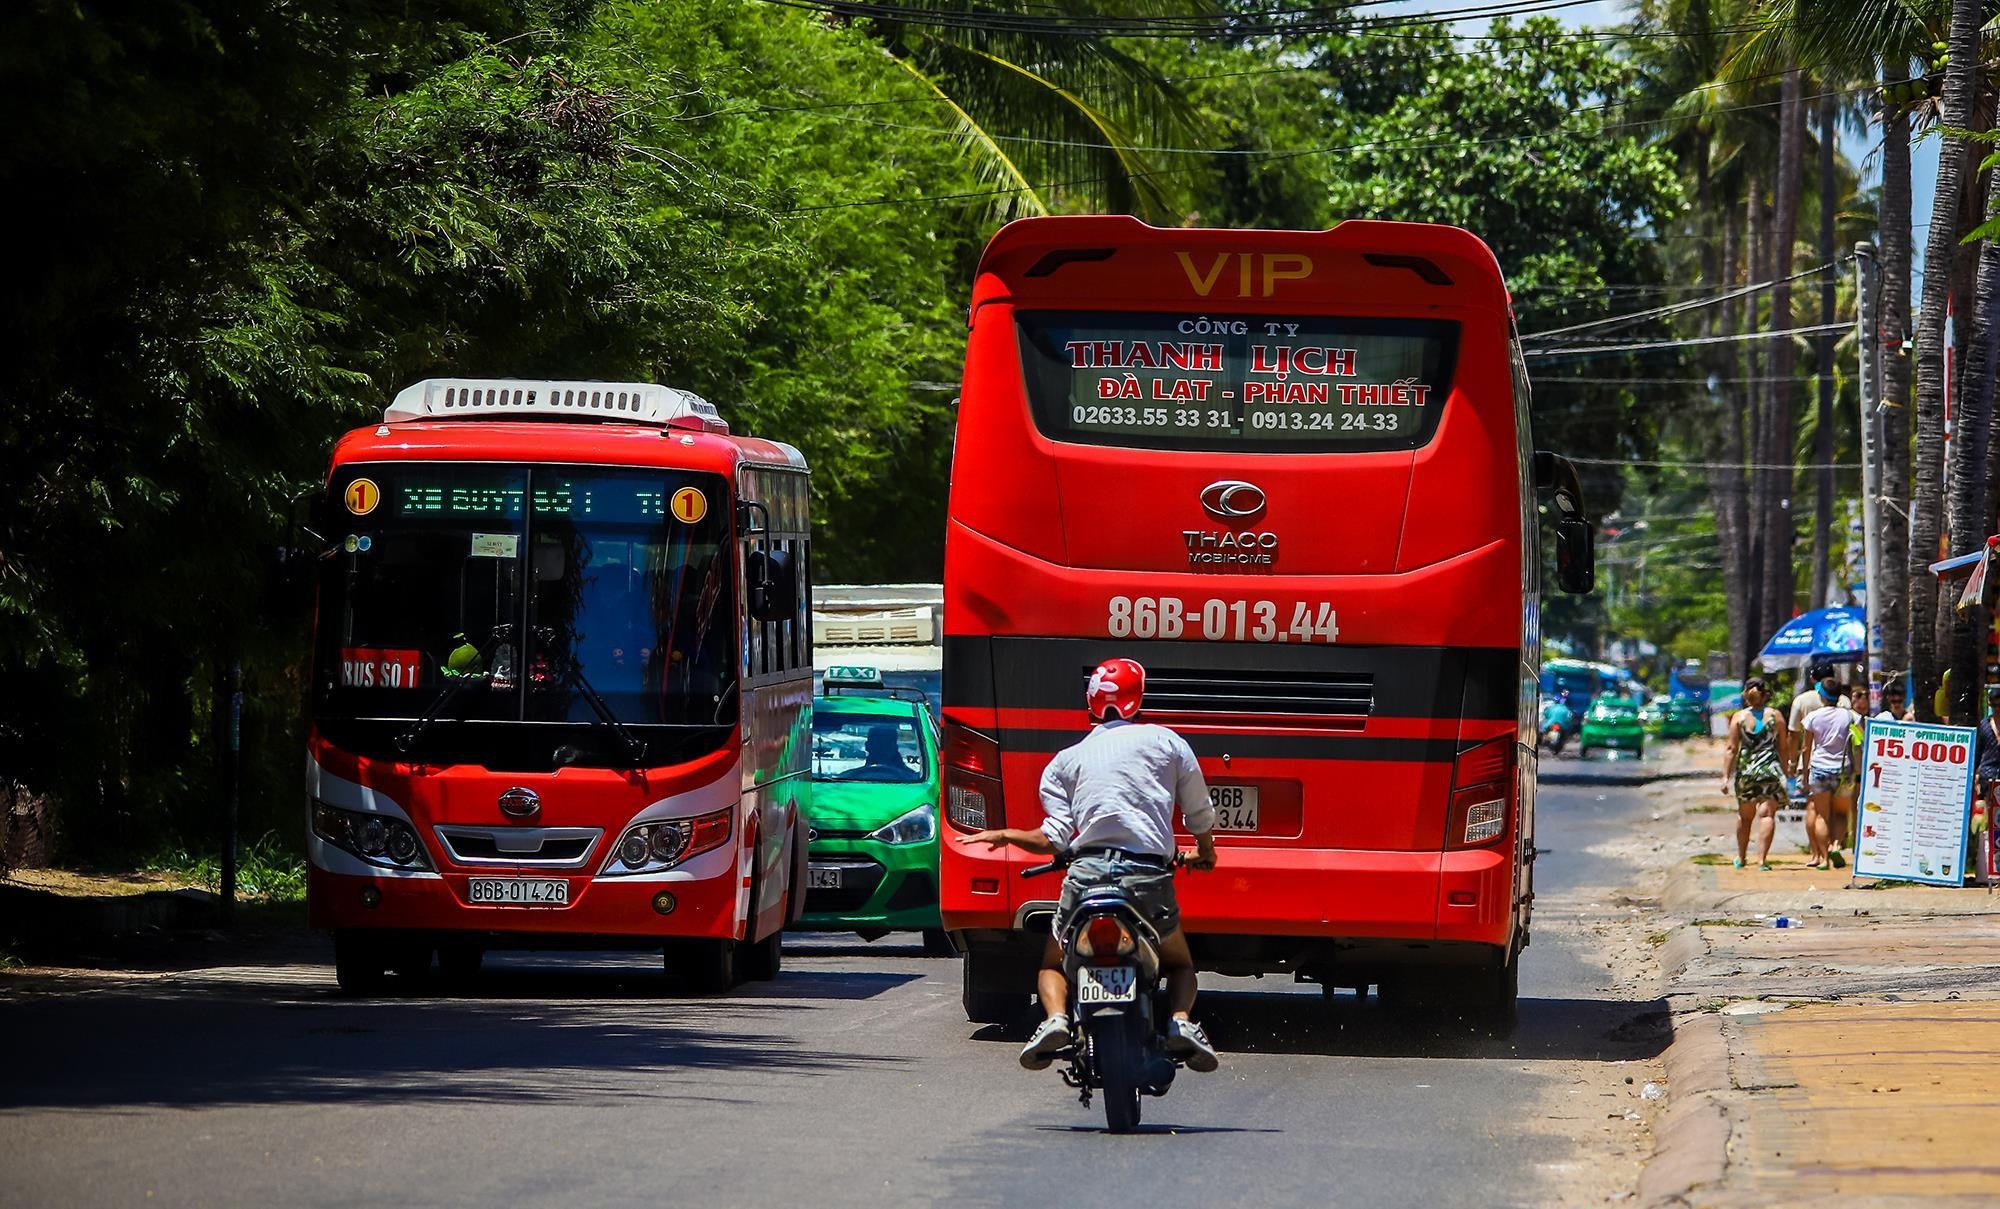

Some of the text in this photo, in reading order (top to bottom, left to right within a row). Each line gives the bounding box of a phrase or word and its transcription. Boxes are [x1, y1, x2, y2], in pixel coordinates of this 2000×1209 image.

[1174, 251, 1313, 298] VIP
[1177, 316, 1300, 338] CÔNG TY
[1064, 340, 1358, 381] THANH LỊCH
[1097, 372, 1144, 400] ĐÀ
[1152, 378, 1213, 404] LẠT
[1243, 381, 1328, 405] PHAN
[1336, 376, 1432, 406] THIẾT
[1072, 405, 1168, 426] 02633.55
[1174, 408, 1201, 427] 33
[1206, 410, 1232, 428] 31
[1251, 411, 1335, 431] 0913.24
[1340, 412, 1367, 431] 24
[1372, 412, 1399, 431] 33
[354, 484, 366, 510] 1
[681, 492, 694, 518] 1
[1182, 530, 1278, 549] THACO
[1188, 552, 1272, 564] MOBIHOME
[1107, 595, 1340, 643] 86B-013.44
[342, 660, 375, 688] BUS
[407, 664, 415, 689] 1
[829, 667, 876, 679] TAXI
[1873, 738, 1967, 765] 15.000
[1209, 787, 1243, 808] 86B
[472, 881, 565, 901] 86B-014.26
